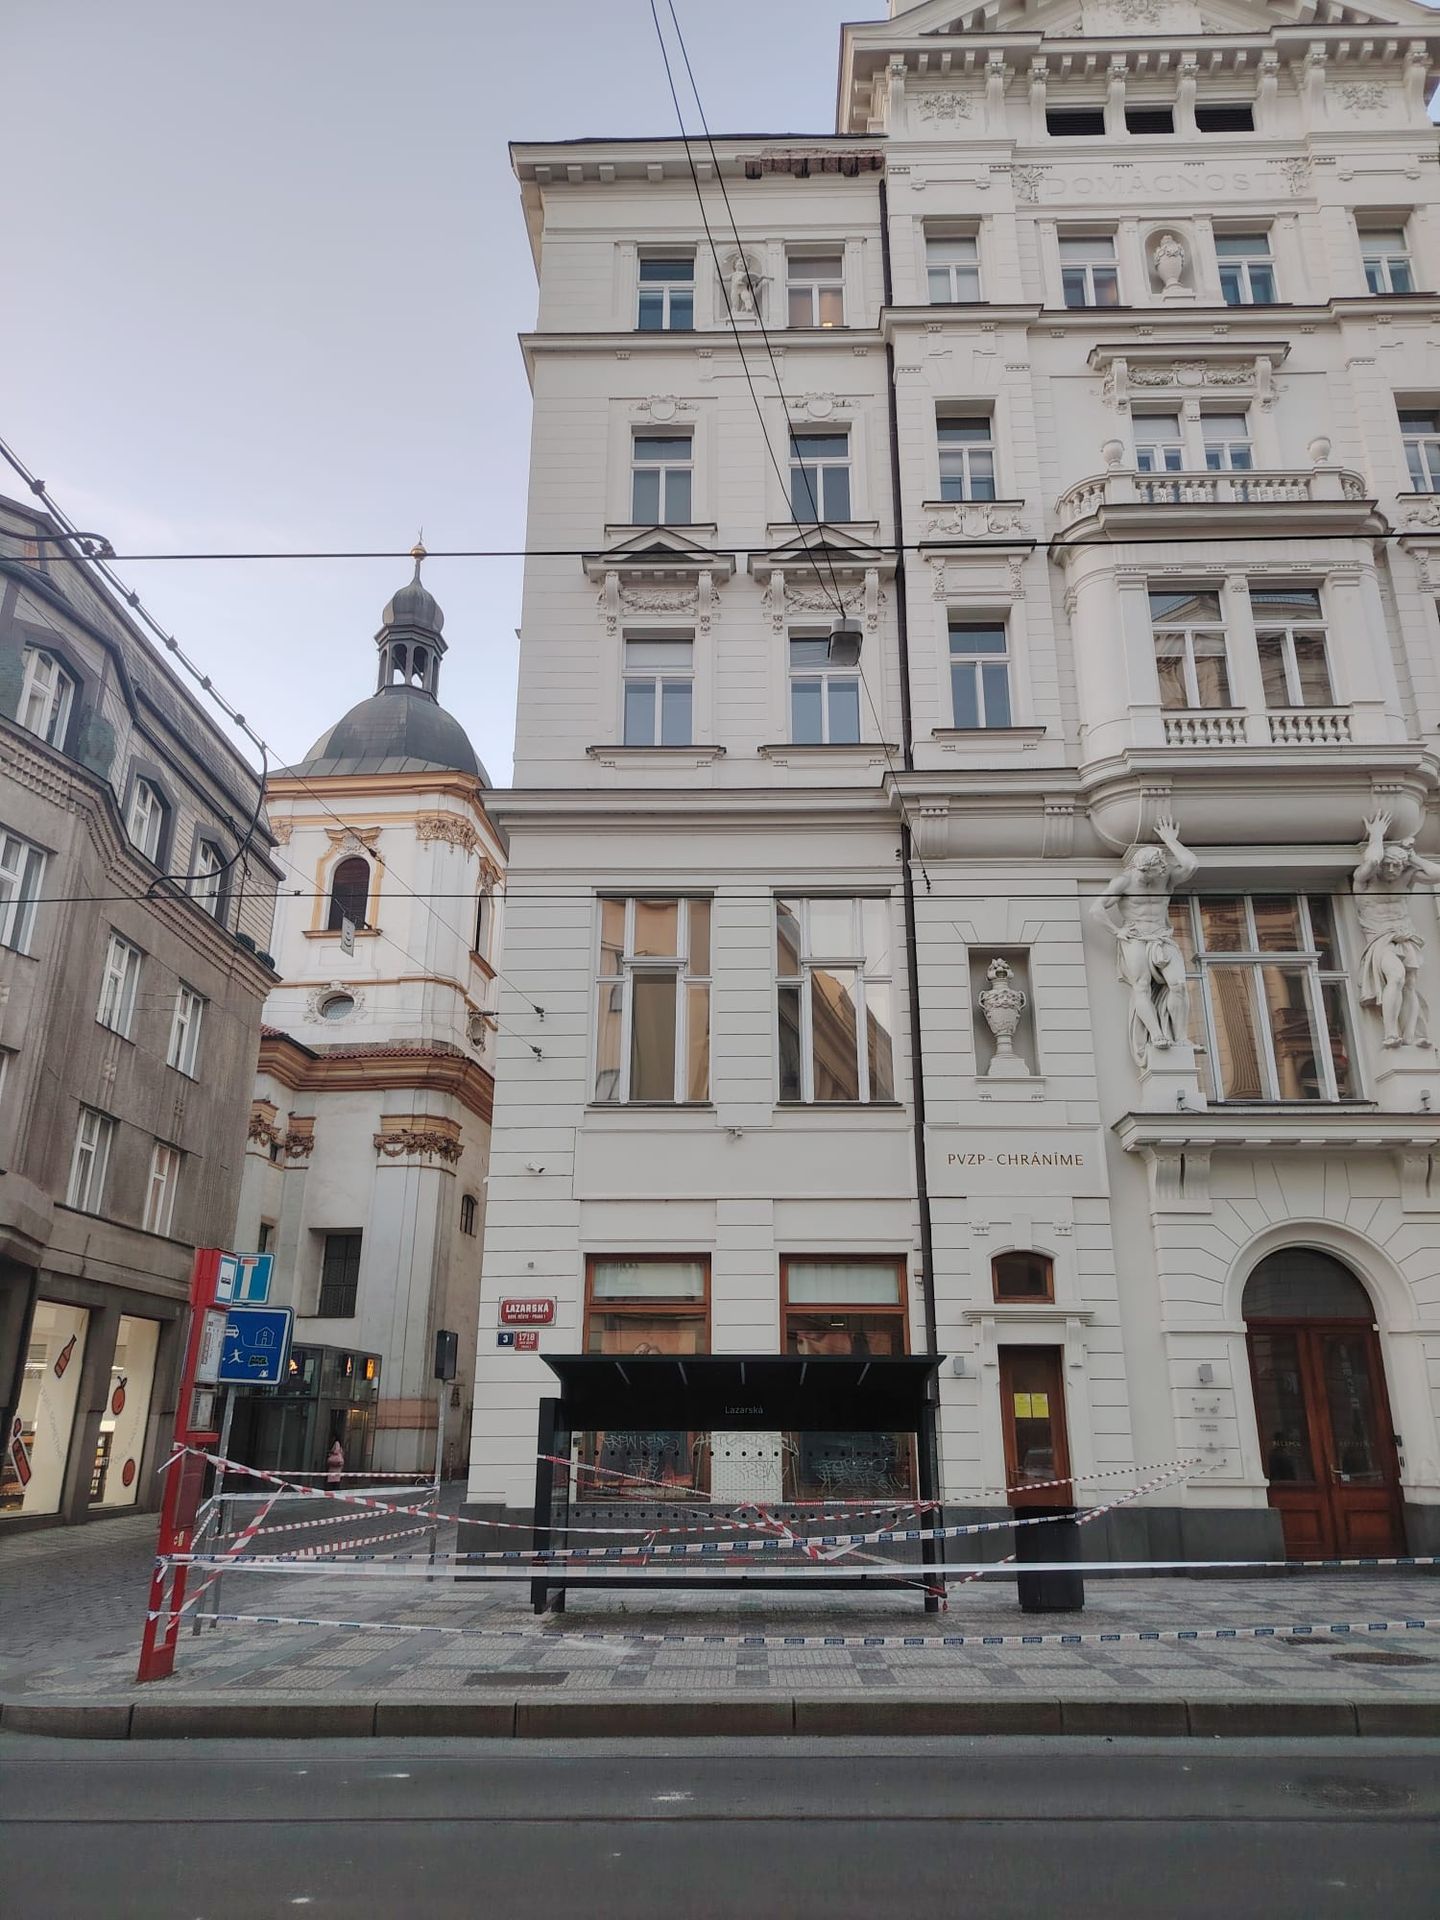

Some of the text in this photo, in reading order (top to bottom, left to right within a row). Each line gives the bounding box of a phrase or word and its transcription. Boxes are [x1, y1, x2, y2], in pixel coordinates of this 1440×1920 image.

[505, 1302, 549, 1313] LAZARSKÁ
[503, 1334, 509, 1343] 3
[519, 1332, 535, 1341] 1718
[725, 1404, 764, 1414] Lazarská
